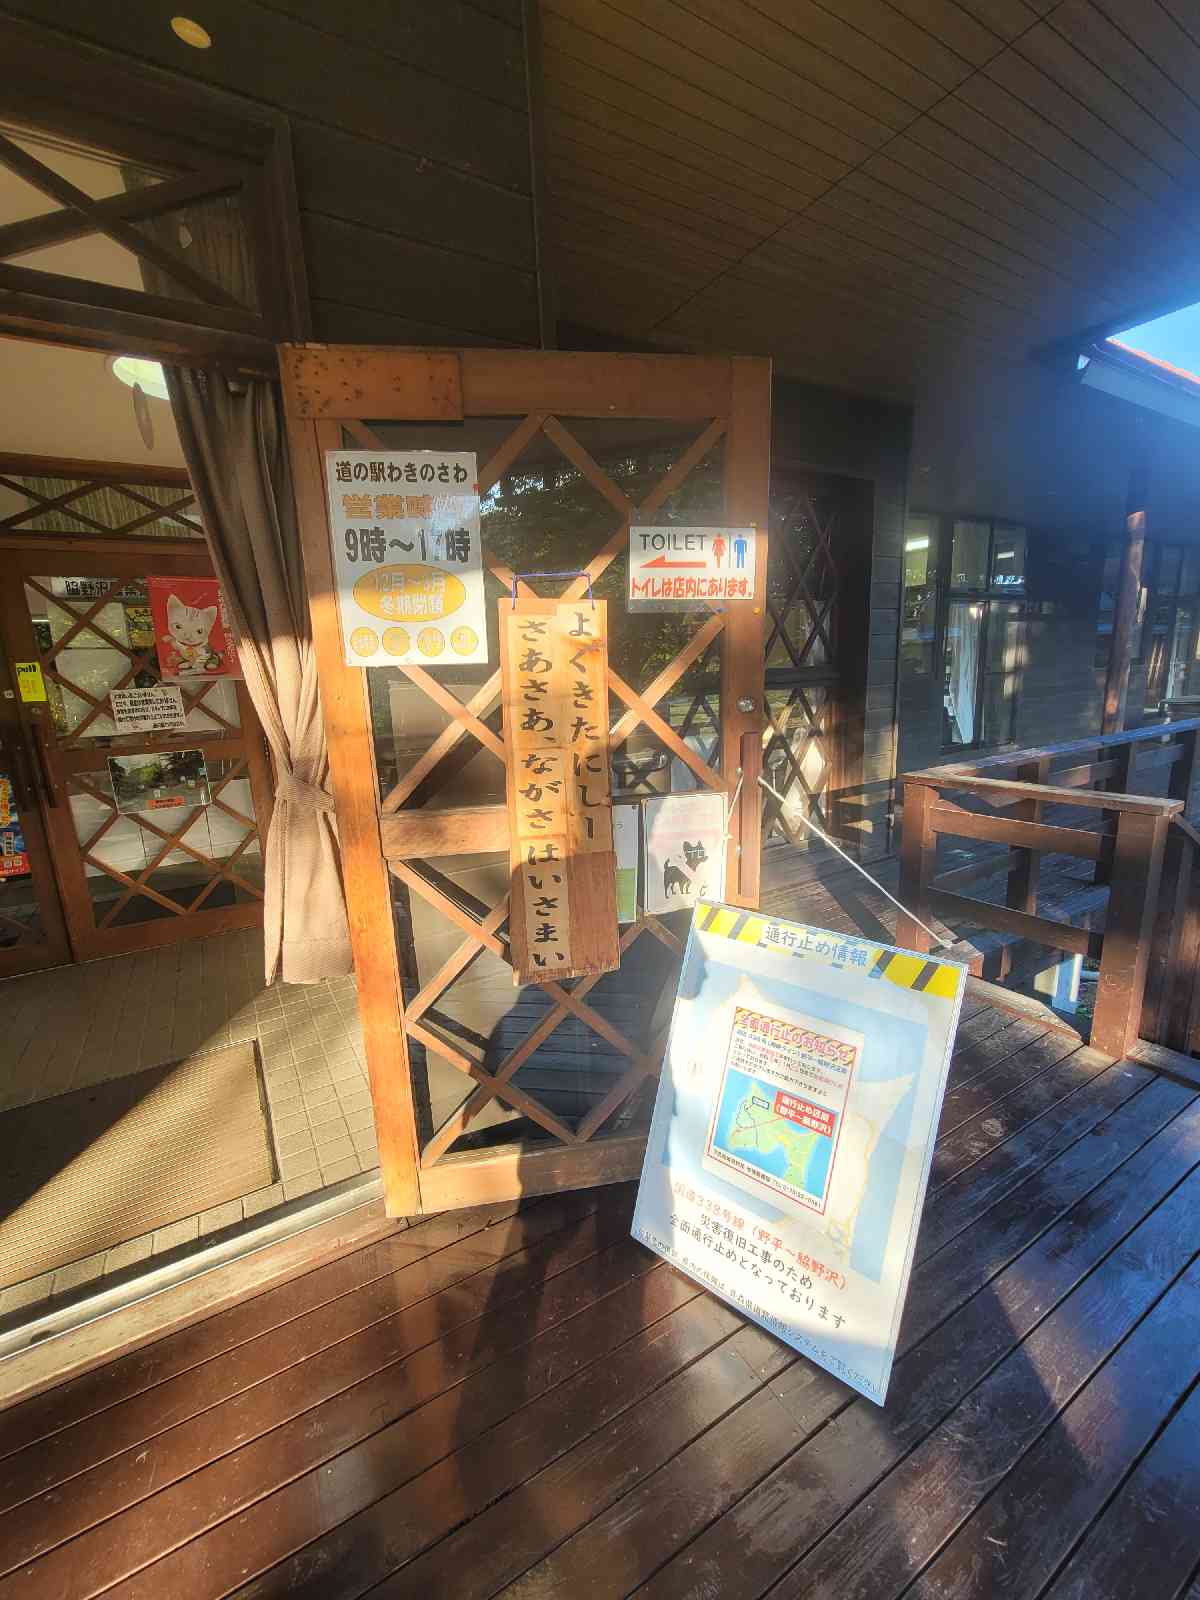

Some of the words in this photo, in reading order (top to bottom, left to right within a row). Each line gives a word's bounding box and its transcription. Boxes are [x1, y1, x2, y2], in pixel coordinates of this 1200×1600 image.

[335, 461, 468, 482] 道の駅わきのさわ
[341, 494, 467, 520] 営業時
[639, 534, 708, 551] TOILET
[766, 926, 869, 967] 通行止め情報
[700, 1213, 813, 1290] 災害復旧工事のため
[669, 1213, 847, 1329] 全面通行止めとなっております
